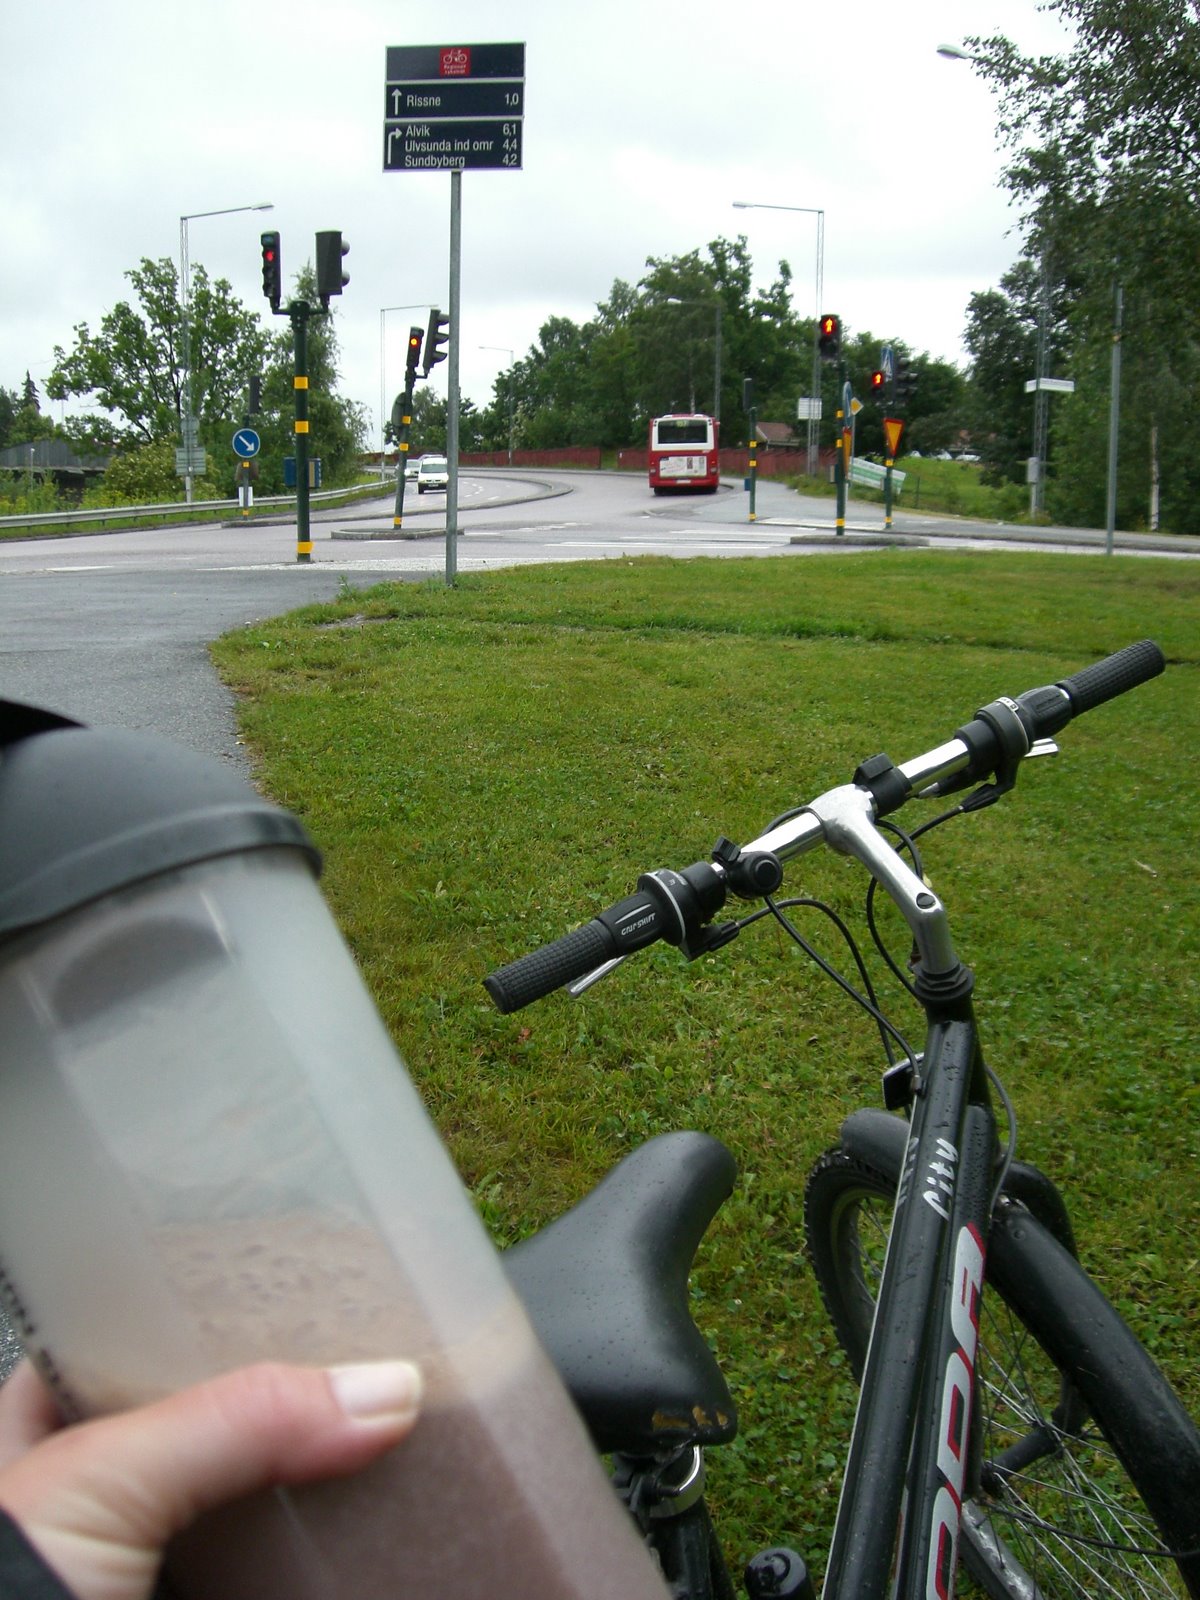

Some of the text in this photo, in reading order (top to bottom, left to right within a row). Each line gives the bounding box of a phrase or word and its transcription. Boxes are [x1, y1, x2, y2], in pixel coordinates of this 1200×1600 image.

[406, 93, 519, 107] Rissne 1,0
[405, 123, 517, 137] Alvik 6,1
[405, 138, 518, 152] Ulvsunda ind omr 4,4
[405, 153, 518, 169] Sundbyberg 4,2
[922, 1137, 959, 1221] City
